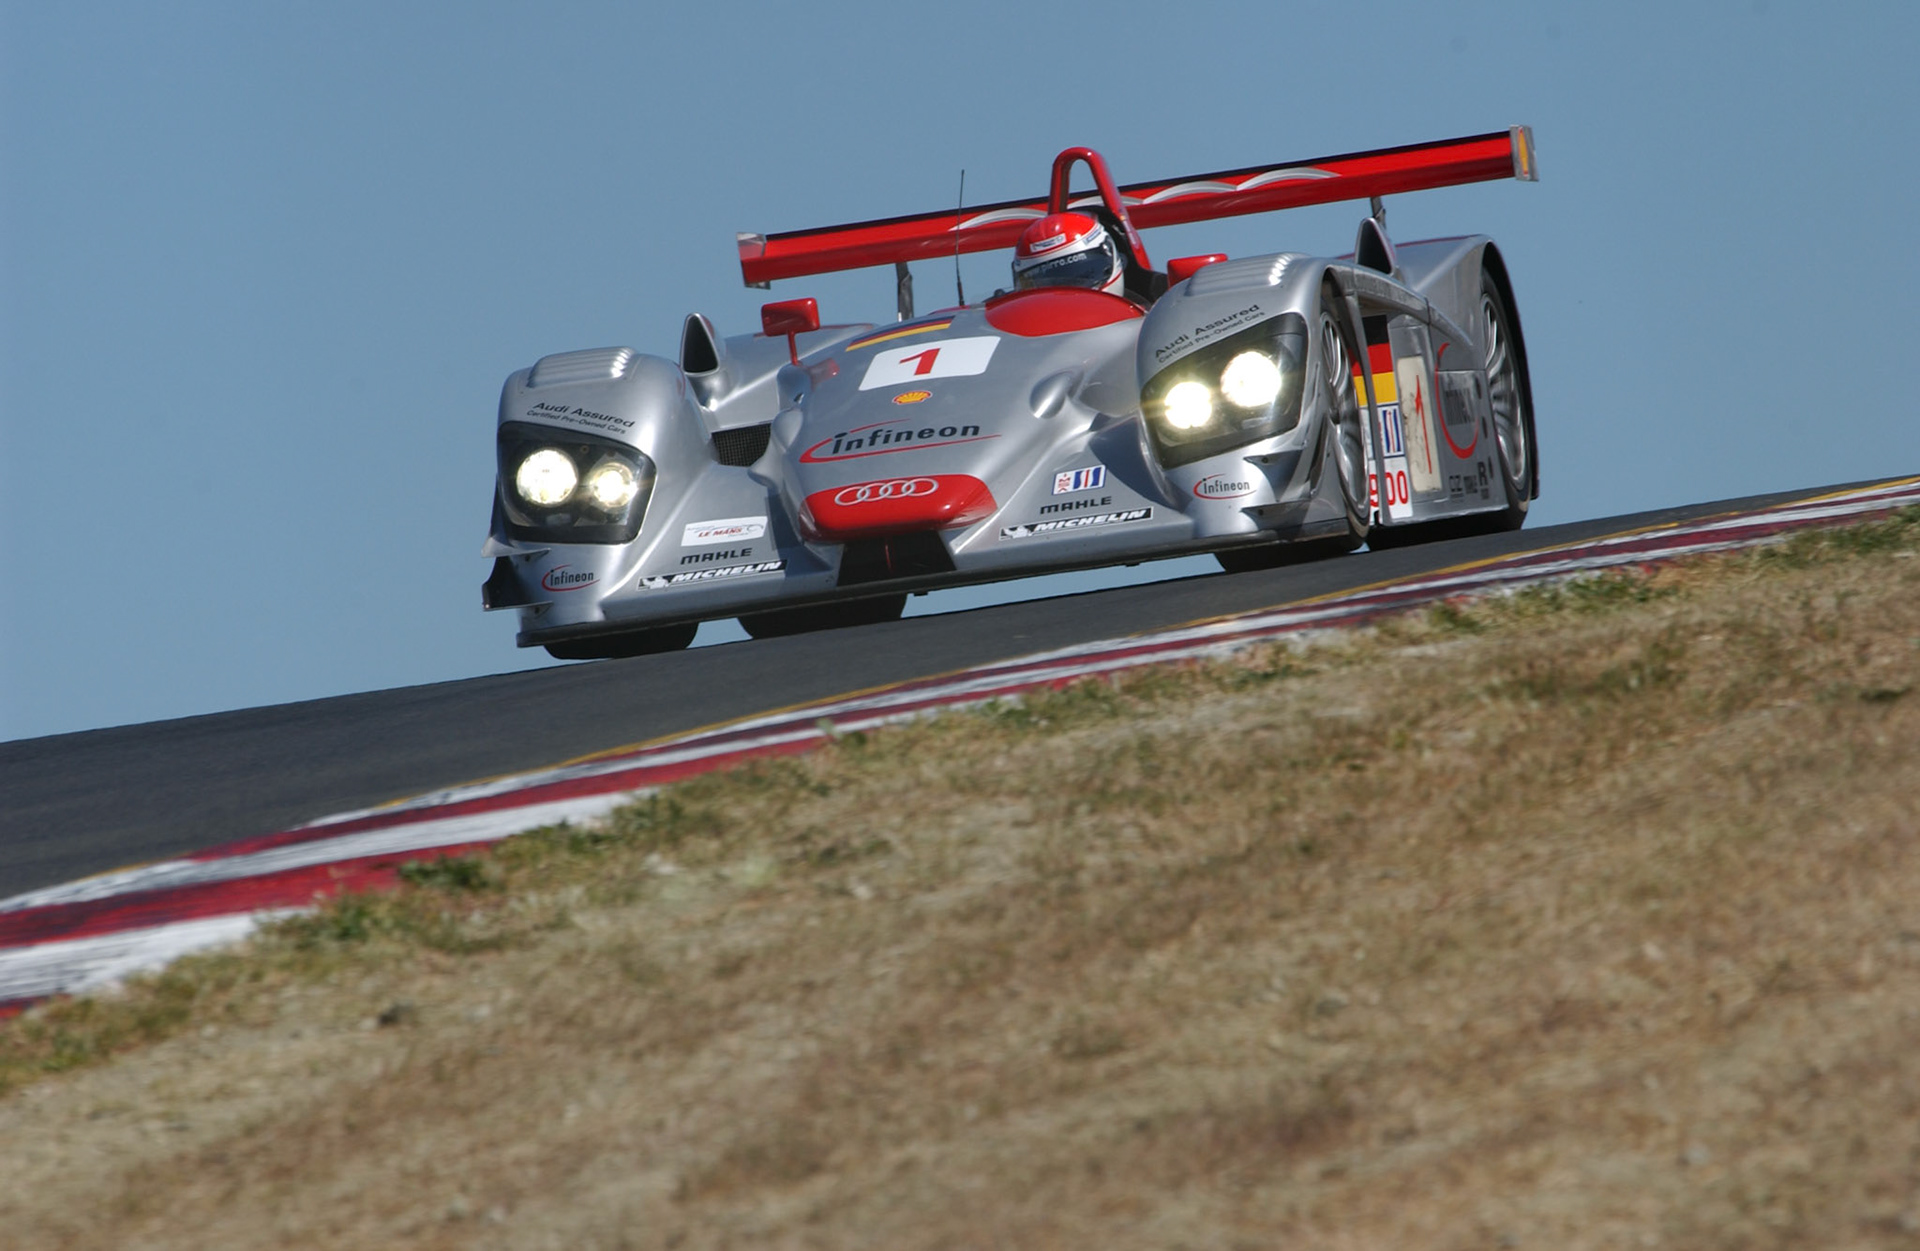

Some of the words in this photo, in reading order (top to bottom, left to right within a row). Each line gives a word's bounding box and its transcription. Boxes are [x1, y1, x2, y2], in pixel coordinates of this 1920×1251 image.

[1154, 333, 1190, 358] Audi
[1194, 304, 1261, 336] Assured
[1158, 341, 1195, 364] Certified
[1194, 319, 1244, 343] Pre-Owned
[1244, 311, 1266, 323] Cars
[898, 347, 942, 376] 1
[526, 410, 561, 421] Certified
[560, 415, 607, 430] Pre-Owned
[607, 424, 627, 435] Cars
[532, 402, 570, 414] Audi
[570, 407, 636, 428] Assured
[1039, 495, 1113, 515] MAHLE
[1034, 508, 1147, 532] MICHELIN
[679, 547, 753, 566] MAHLE
[671, 560, 783, 583] MICHELIN
